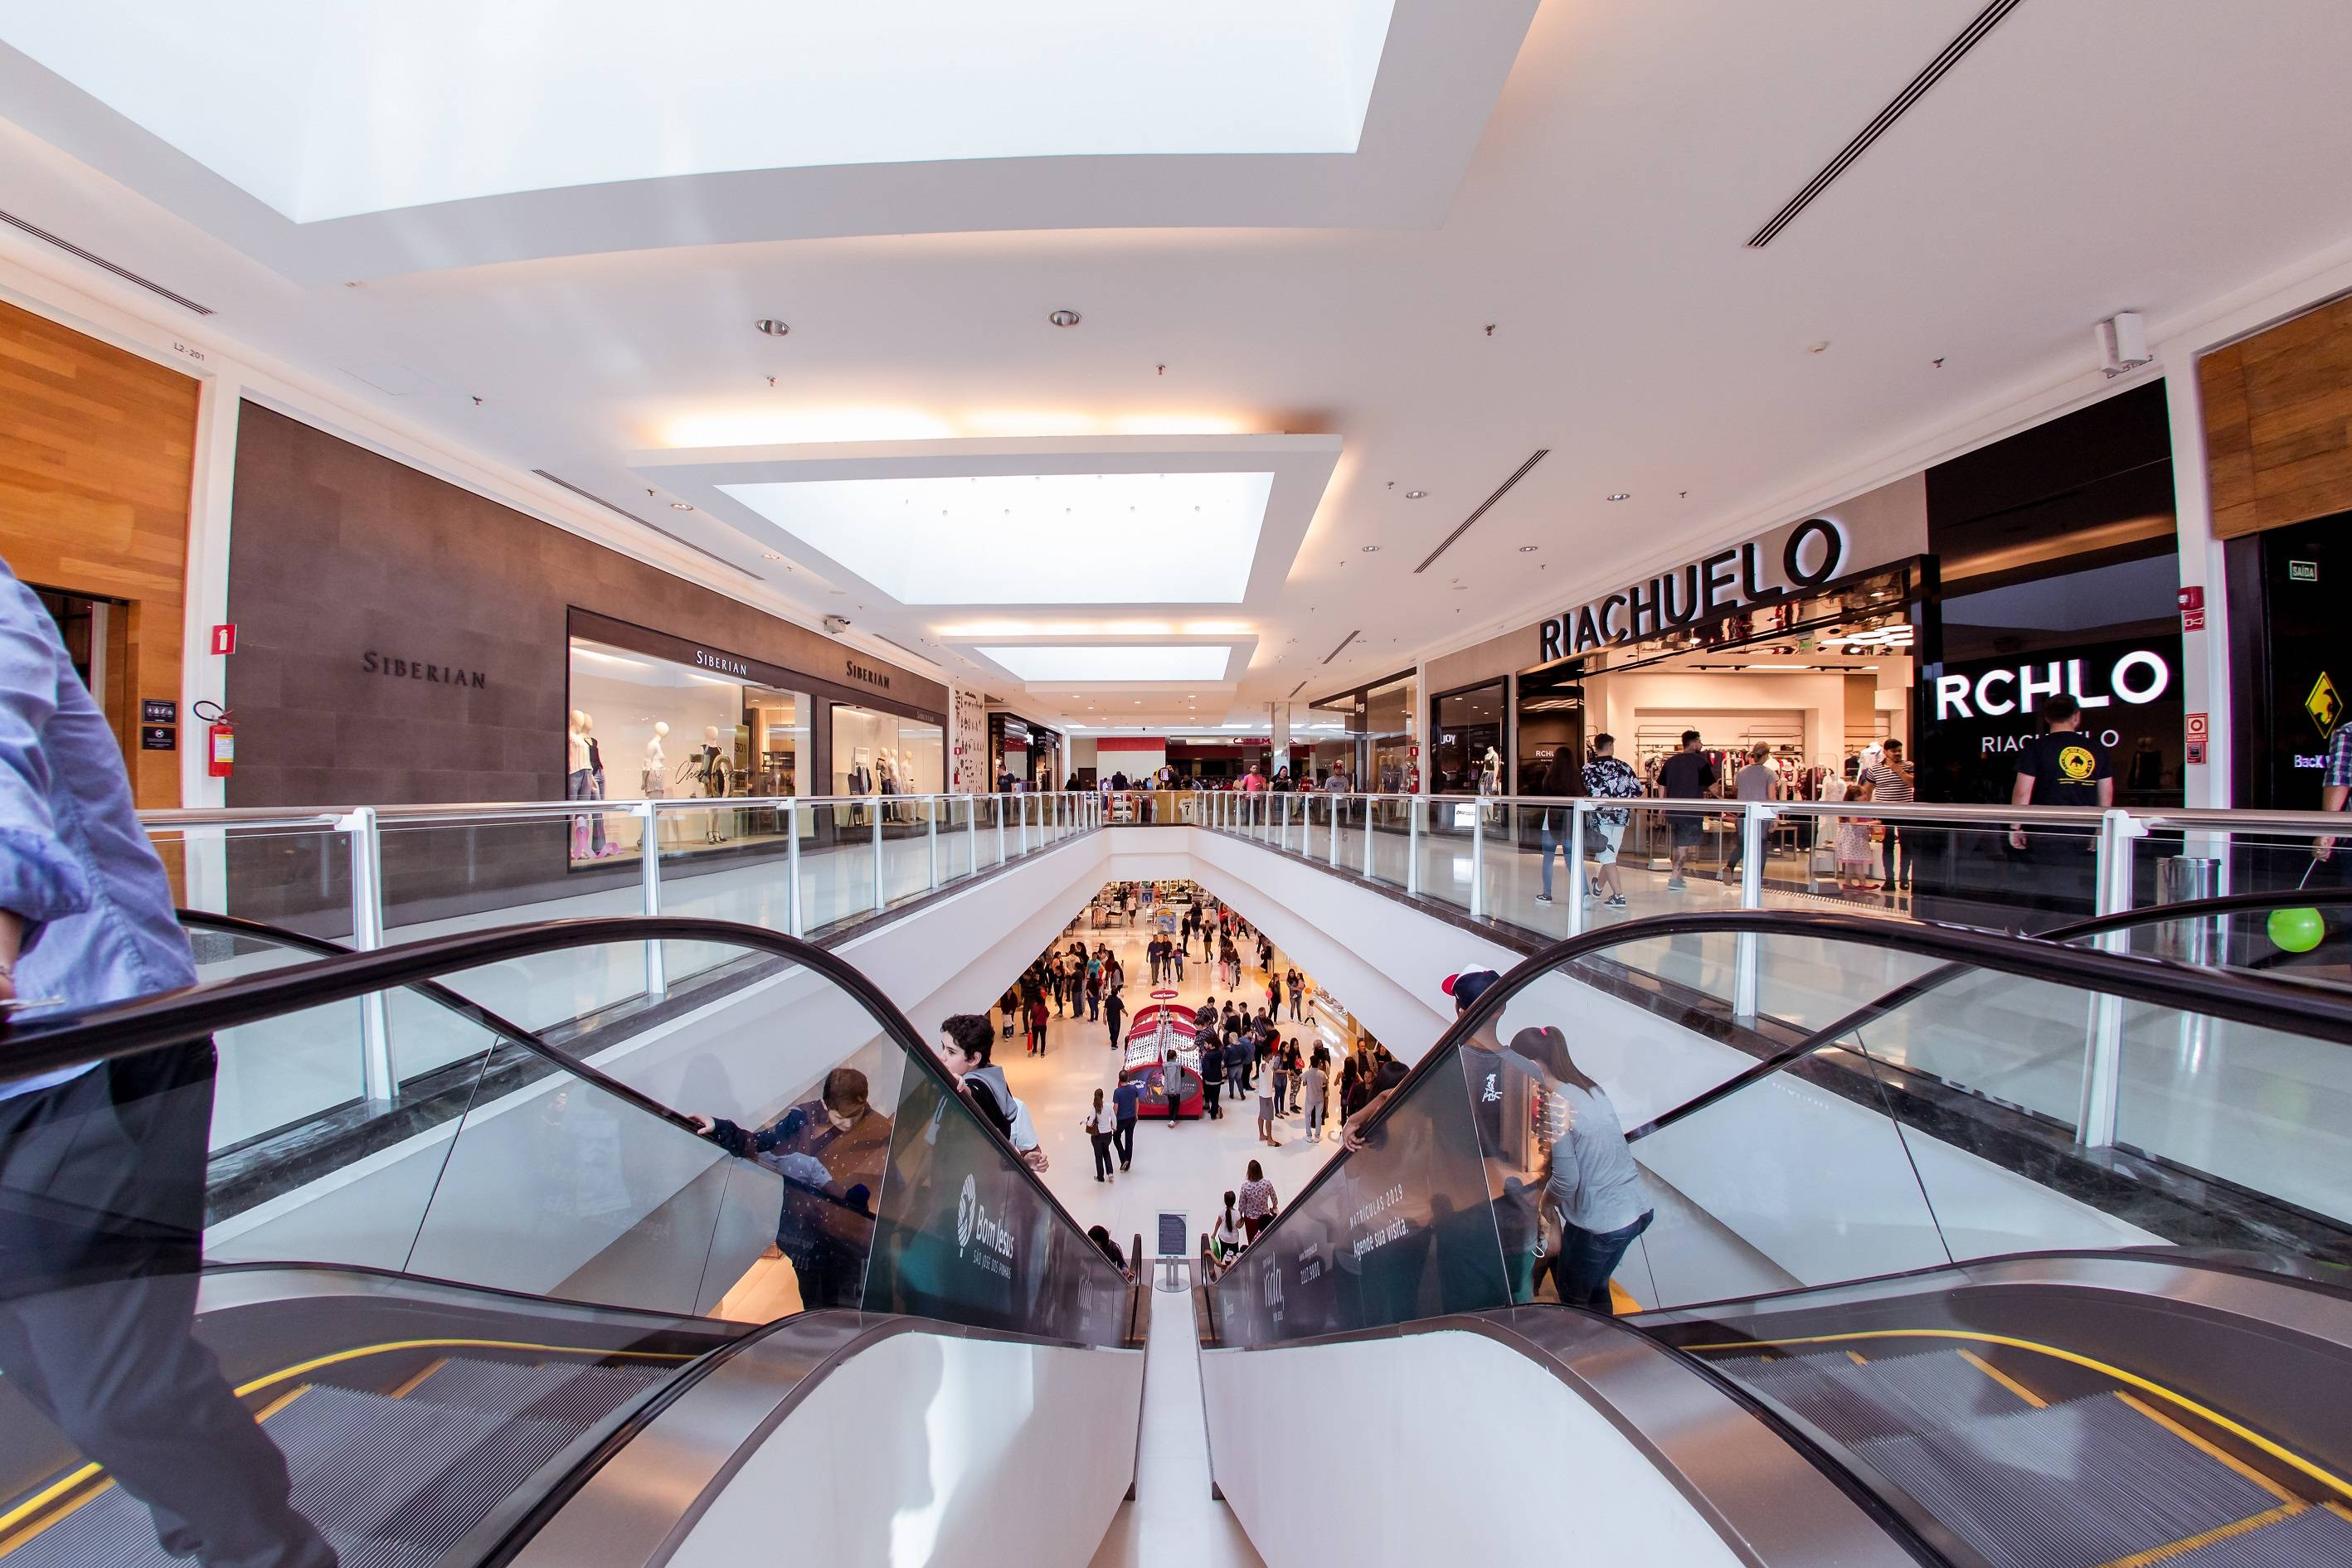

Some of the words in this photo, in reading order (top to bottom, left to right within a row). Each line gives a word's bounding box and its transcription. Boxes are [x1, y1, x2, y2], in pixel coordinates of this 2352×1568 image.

[1539, 518, 1842, 664] RIACHUELO
[2291, 565, 2315, 578] SAÍDA
[363, 650, 486, 690] SIBERIAN
[696, 650, 747, 676] SIBERIAN
[846, 660, 890, 690] SIBERIAN
[1936, 650, 2170, 721] RCHLO
[1980, 729, 2120, 753] RIACO
[1184, 804, 1191, 816] 7
[1349, 1195, 1384, 1230] MATRÍCULAS
[1386, 1183, 1403, 1207] 2019
[975, 1204, 996, 1249] Bom
[994, 1218, 1015, 1260] Jesus
[1353, 1231, 1374, 1262] Agende
[1374, 1229, 1387, 1248] sua
[1386, 1216, 1409, 1242] visita.
